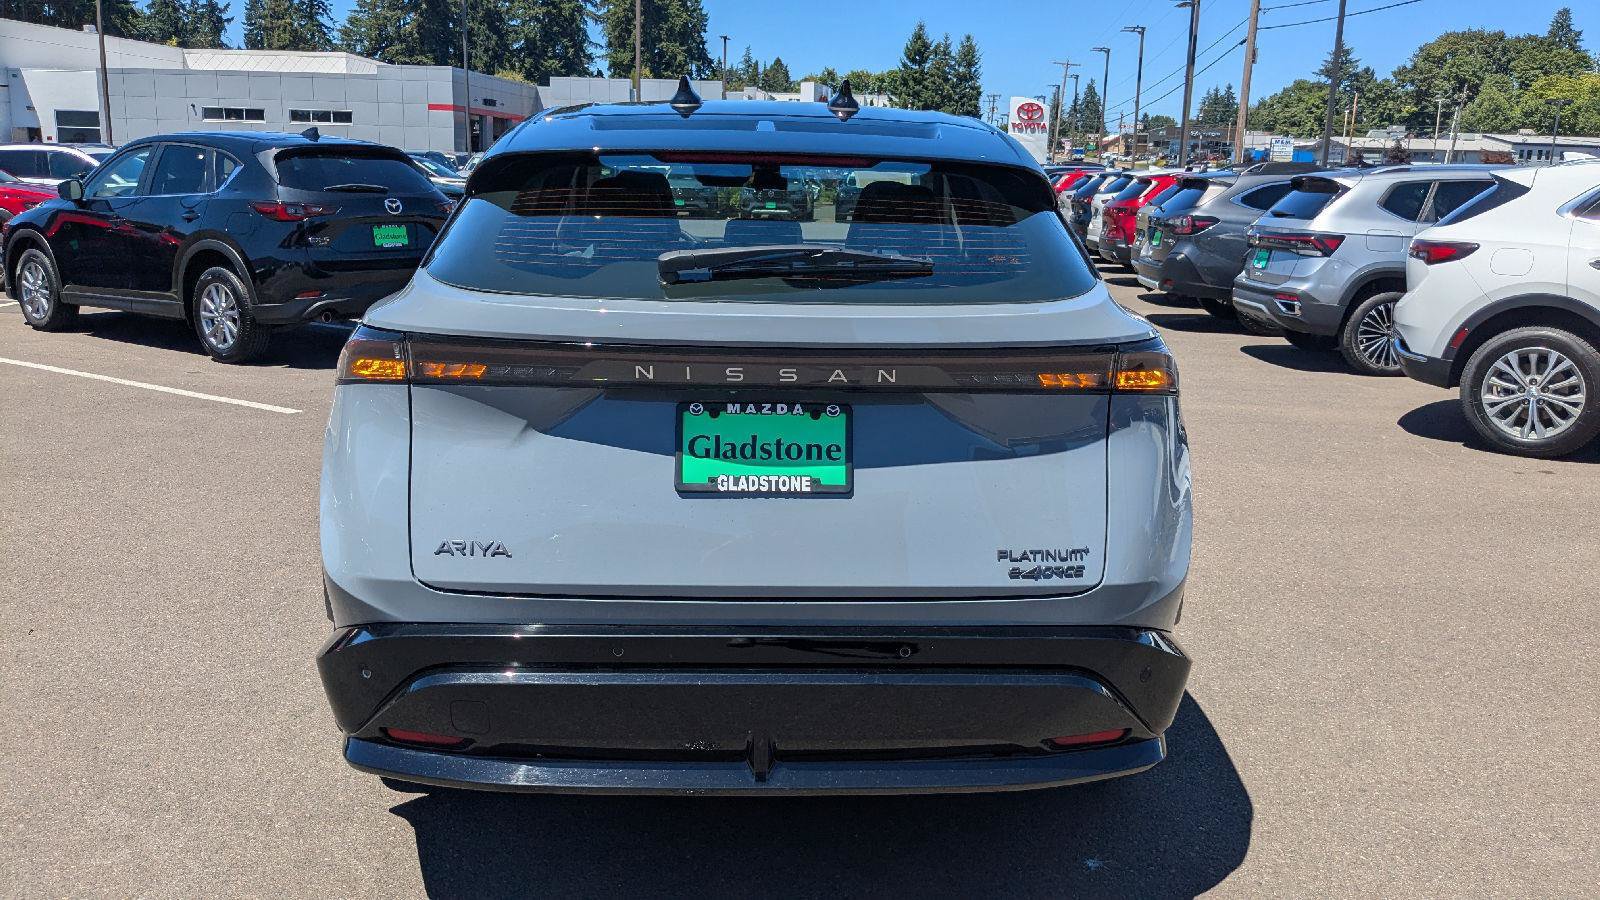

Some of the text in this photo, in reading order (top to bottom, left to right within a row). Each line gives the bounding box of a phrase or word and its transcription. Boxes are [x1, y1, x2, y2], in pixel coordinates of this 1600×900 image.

[1011, 122, 1047, 132] TOYOTA
[634, 365, 897, 383] NISSAN
[726, 403, 804, 415] MAZDA
[688, 434, 842, 461] Gladstone
[717, 475, 811, 492] GLADSTONE
[433, 538, 512, 558] ARIYA
